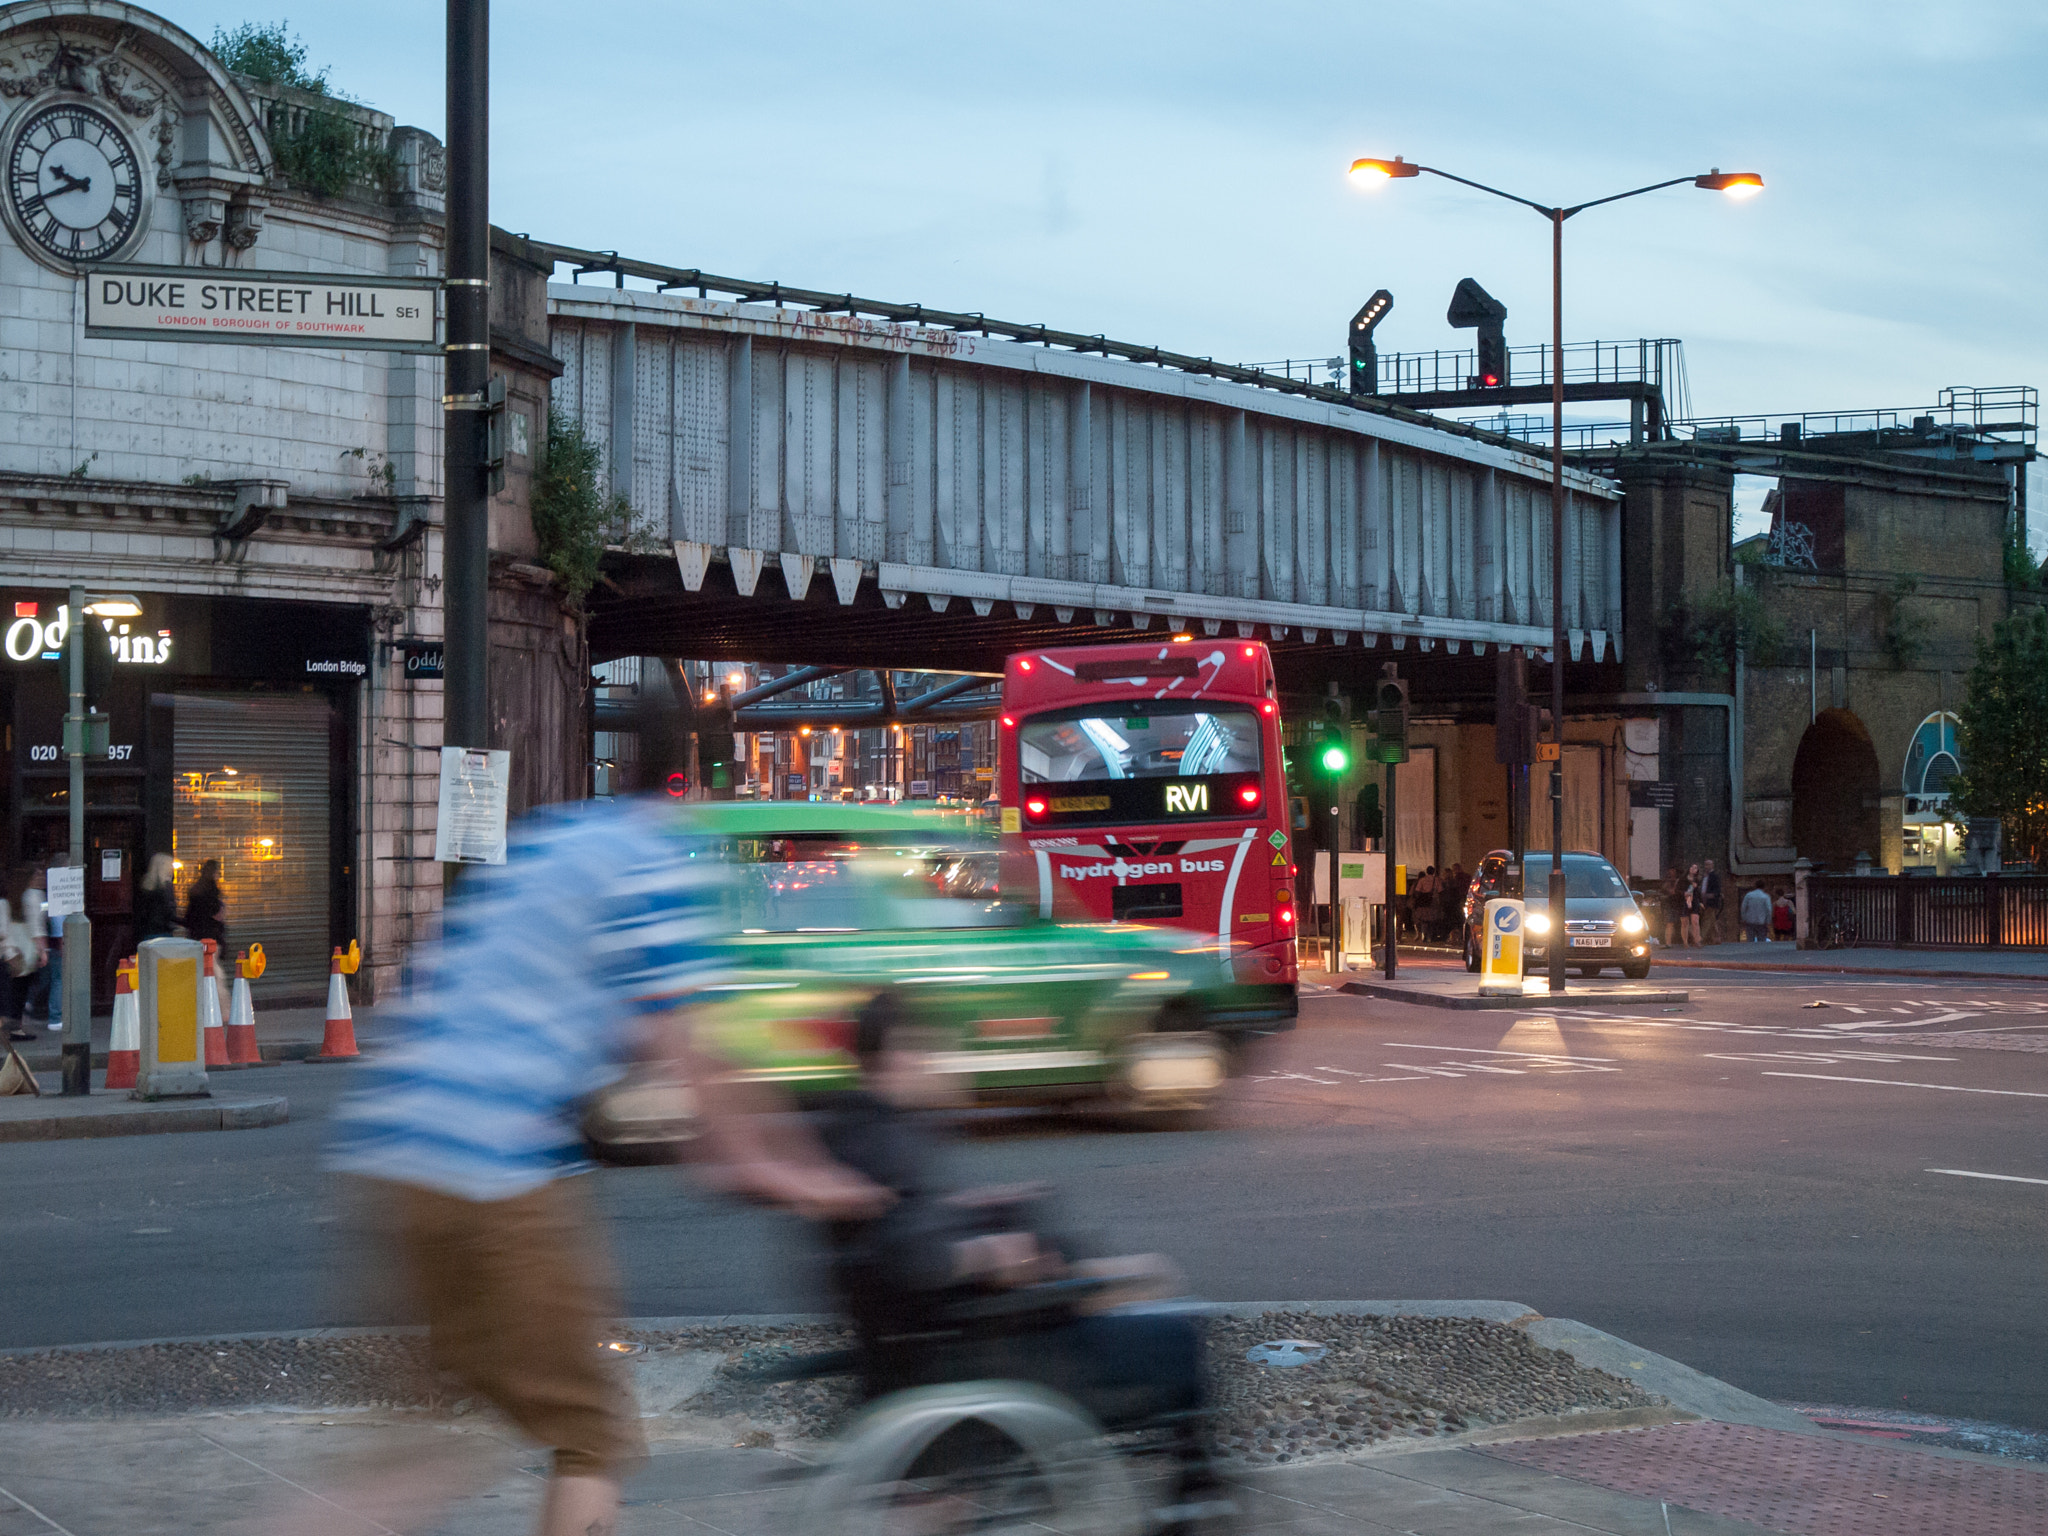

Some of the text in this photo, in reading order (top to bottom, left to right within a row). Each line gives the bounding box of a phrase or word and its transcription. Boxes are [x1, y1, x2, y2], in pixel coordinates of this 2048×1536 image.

[103, 280, 419, 319] DUKE STREET HILL SE1
[158, 315, 365, 333] LONDON BOROUGH OF SOUTHWARK
[5, 603, 171, 664] Odins
[306, 660, 366, 675] London Bridge
[31, 745, 57, 761] 020
[1060, 859, 1225, 881] hydrogen bus
